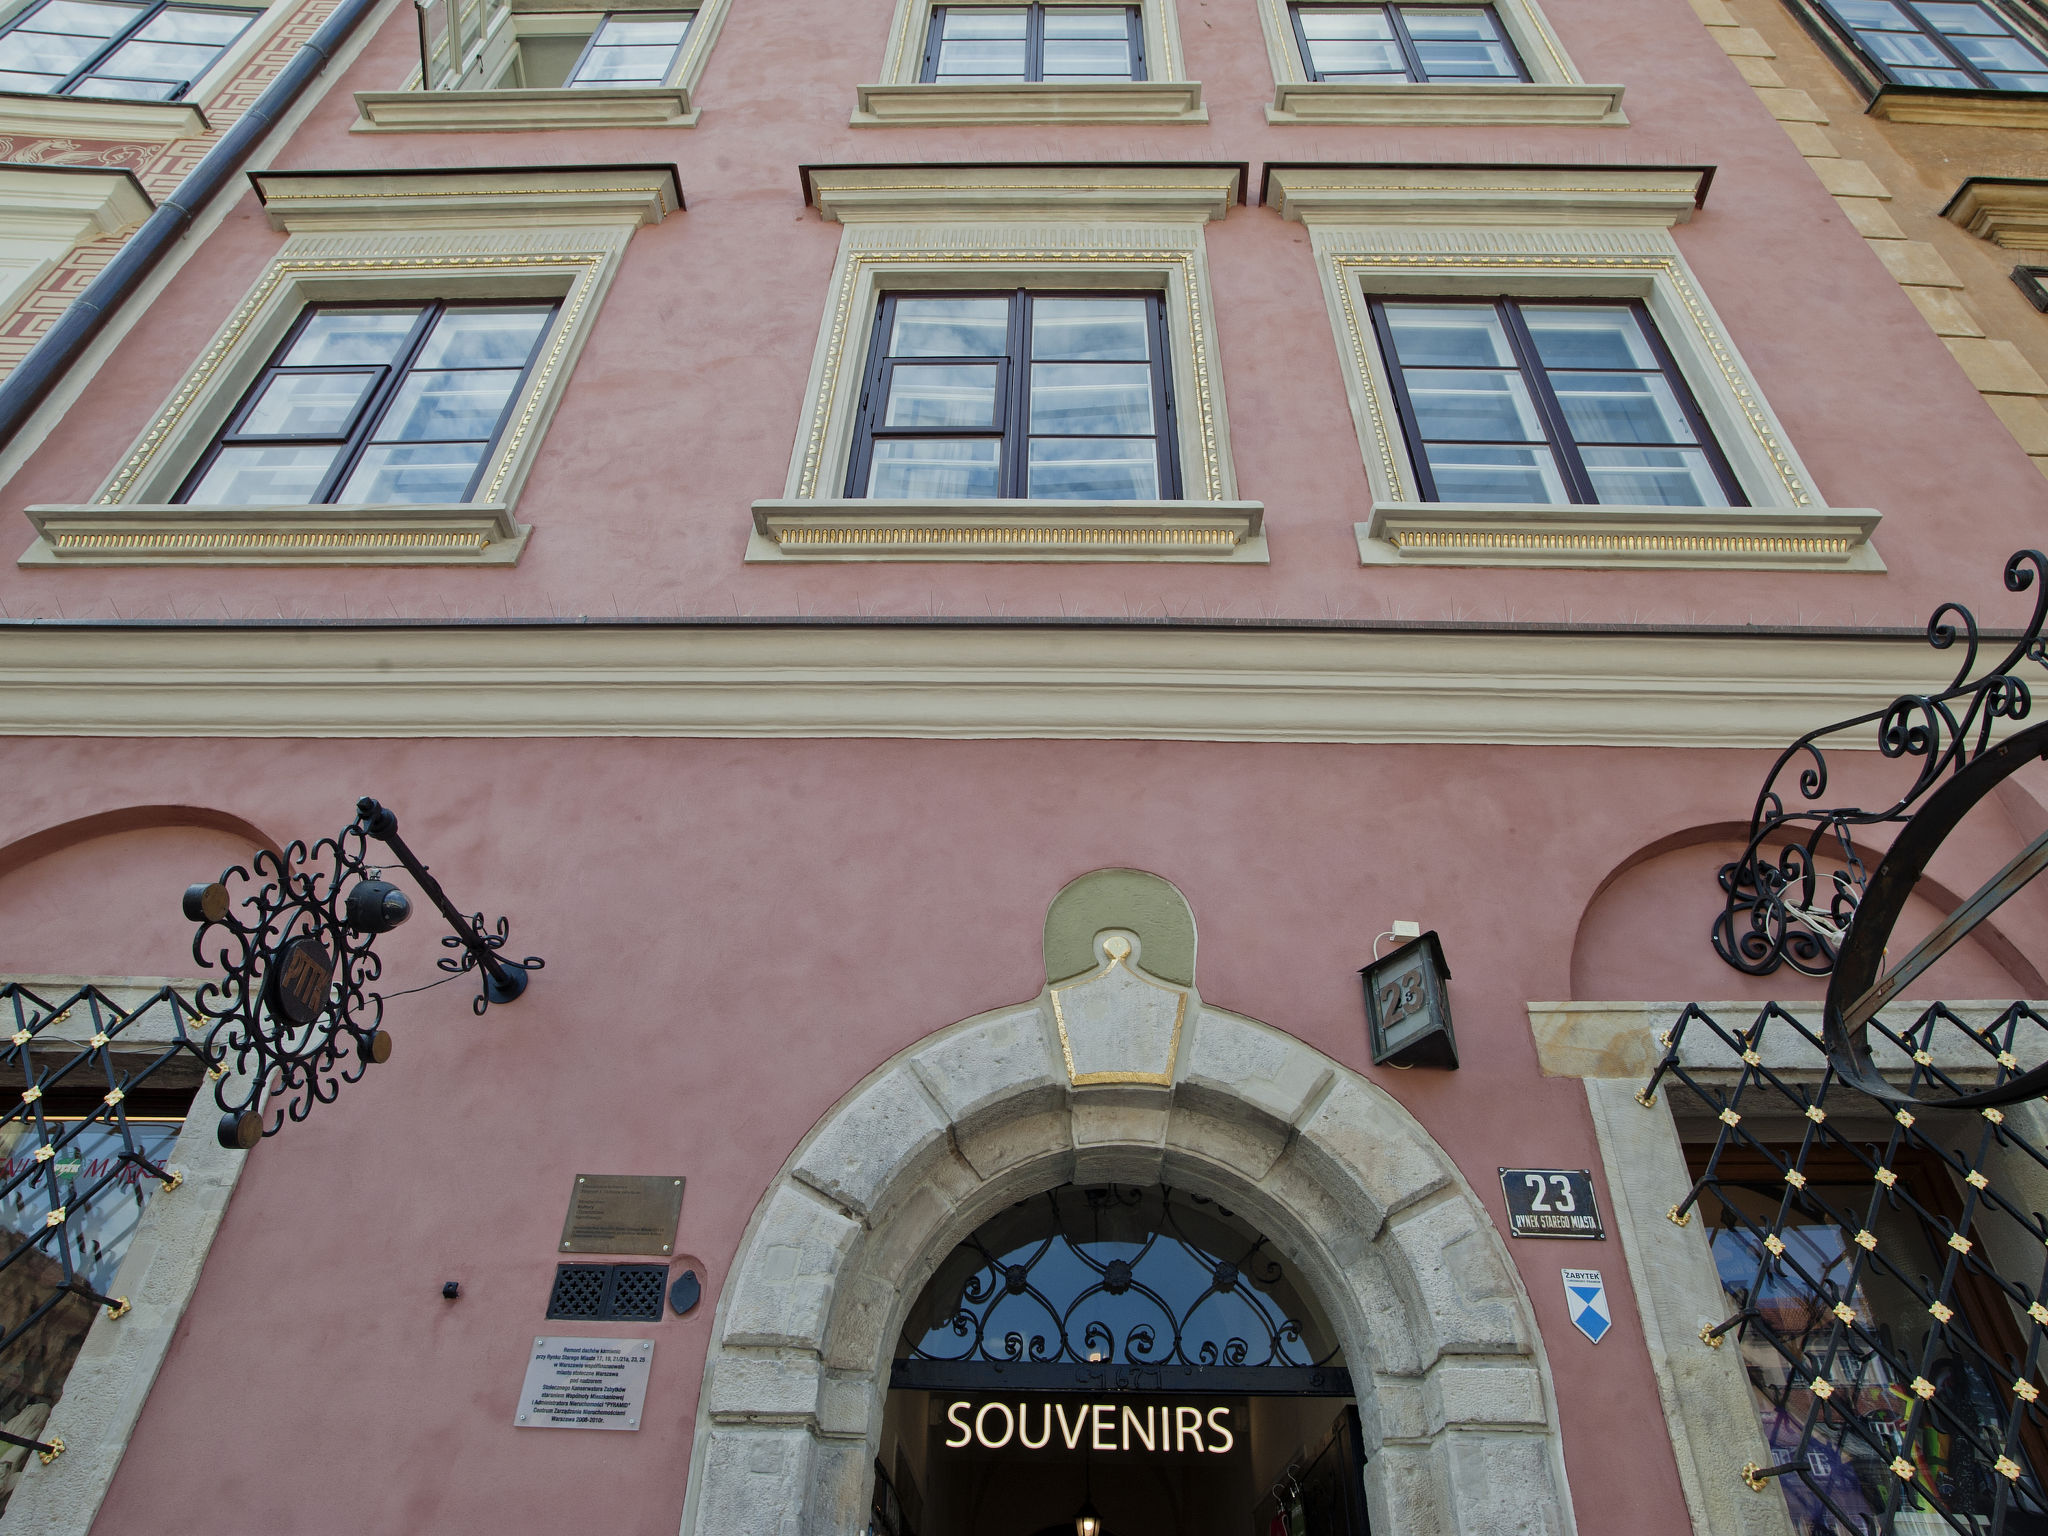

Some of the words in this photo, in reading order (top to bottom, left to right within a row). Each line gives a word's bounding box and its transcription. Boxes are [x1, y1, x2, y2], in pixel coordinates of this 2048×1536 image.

[281, 946, 331, 1012] PTTK
[1380, 969, 1424, 1029] 23
[1524, 1174, 1575, 1212] 23
[1515, 1214, 1540, 1228] RYNEK
[1540, 1215, 1570, 1229] STAREGO
[1570, 1215, 1596, 1229] MIASTA
[1565, 1272, 1600, 1280] ZABYTEK
[945, 1401, 1234, 1453] SOUVENIRS
